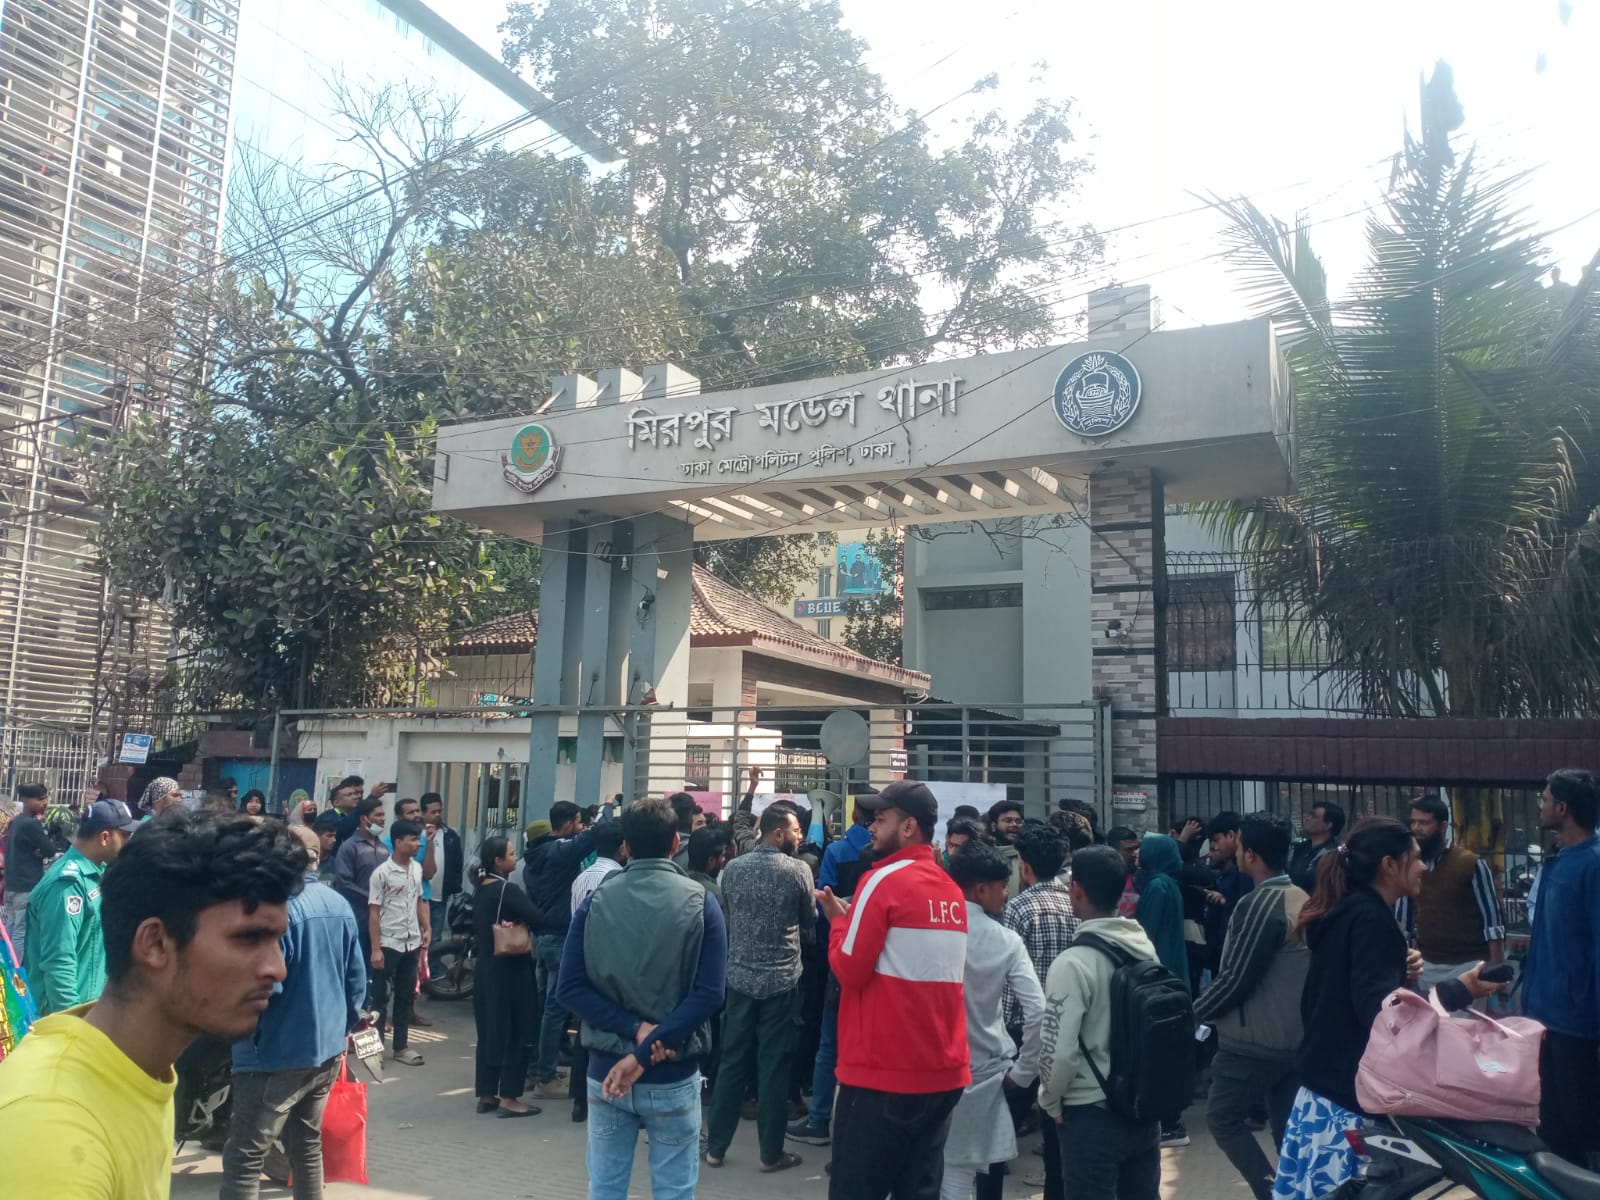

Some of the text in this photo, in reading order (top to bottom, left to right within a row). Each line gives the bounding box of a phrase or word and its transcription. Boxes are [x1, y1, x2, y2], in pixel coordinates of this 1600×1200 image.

[626, 373, 965, 450] মিরপুর মডেল থানা
[859, 441, 895, 458] ঢাকা
[928, 899, 964, 925] L.F.C.
